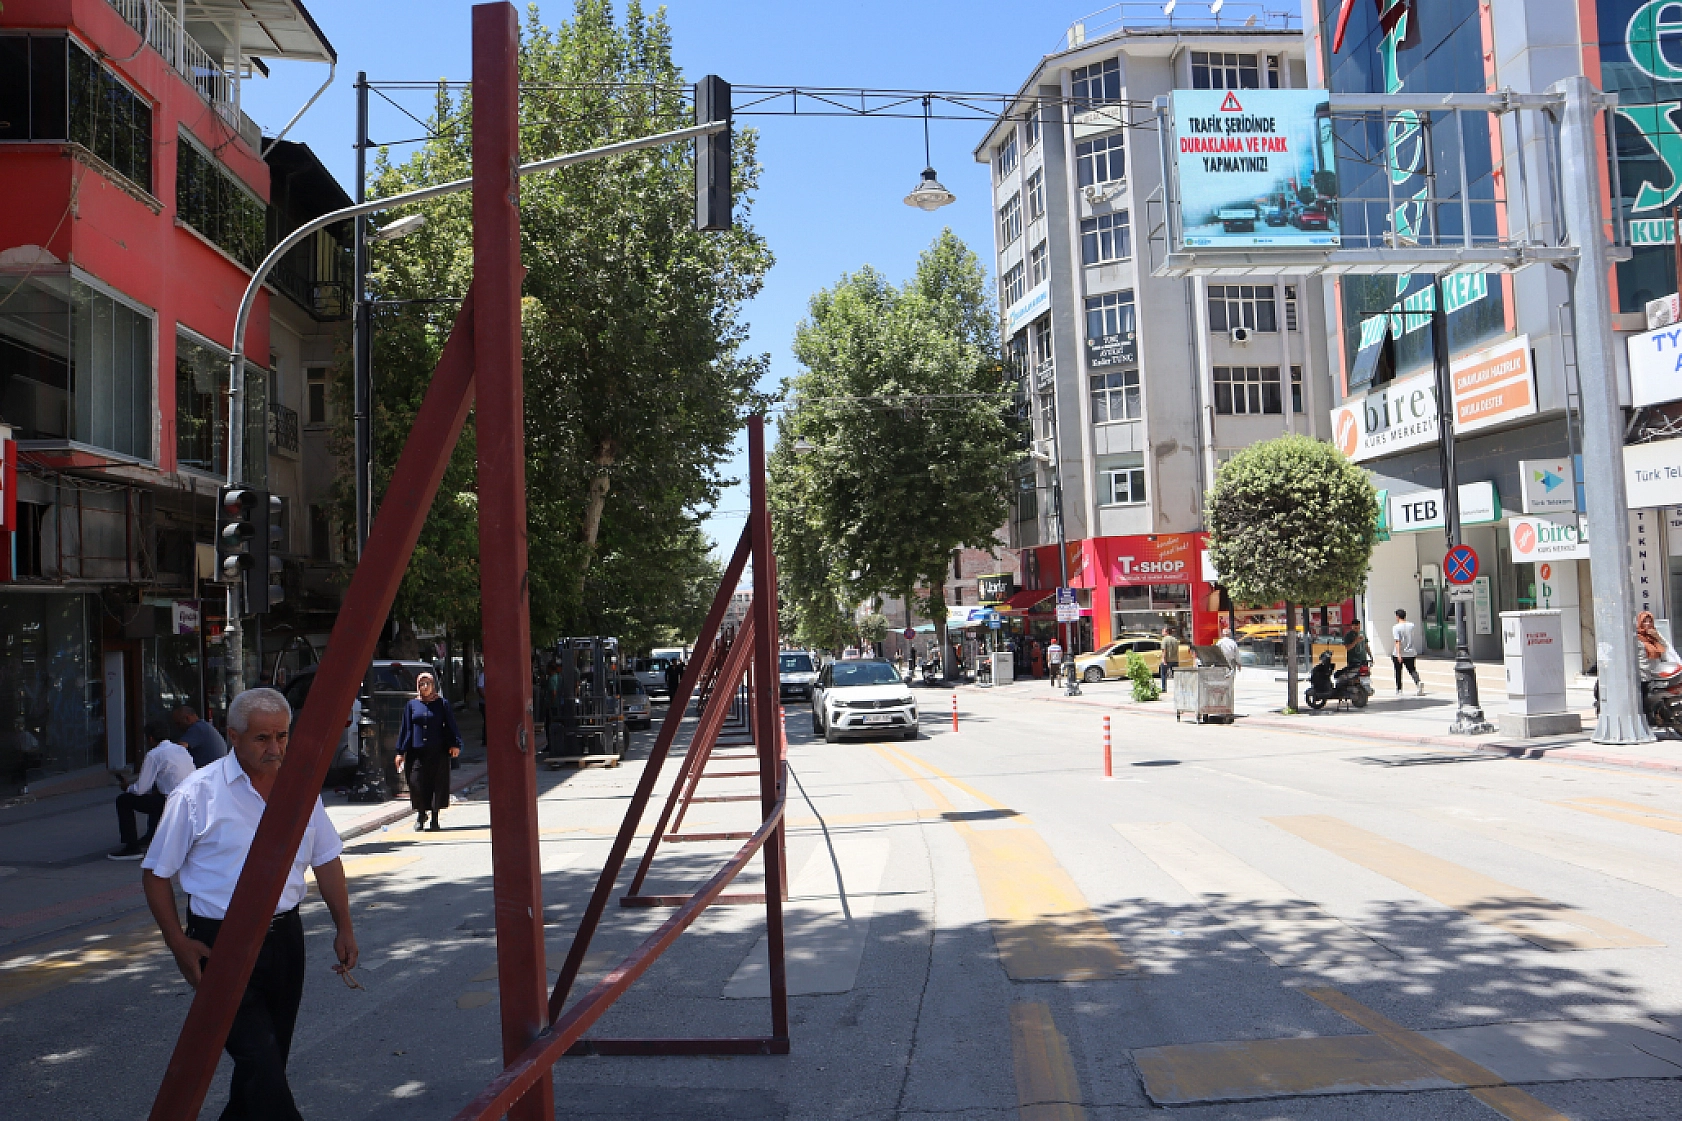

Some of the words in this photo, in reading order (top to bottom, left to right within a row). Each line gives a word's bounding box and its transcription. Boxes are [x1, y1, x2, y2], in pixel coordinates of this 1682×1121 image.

[1189, 115, 1223, 133] TRAFİK
[1225, 114, 1276, 136] ŞERİDİNDE
[1180, 136, 1244, 153] DURAKLAMA
[1246, 137, 1259, 153] VE
[1261, 136, 1288, 153] PARK
[1202, 156, 1269, 173] YAPMAYINIZ!
[1652, 329, 1682, 352] TY
[1457, 371, 1490, 390] SINAVLARA
[1490, 356, 1521, 377] HAZIRLIK
[1479, 394, 1503, 411] DESTEK
[1364, 435, 1387, 449] KURS
[1390, 416, 1434, 440] MERKEZİ
[1635, 468, 1661, 483] Türk
[1401, 500, 1437, 524] TEB
